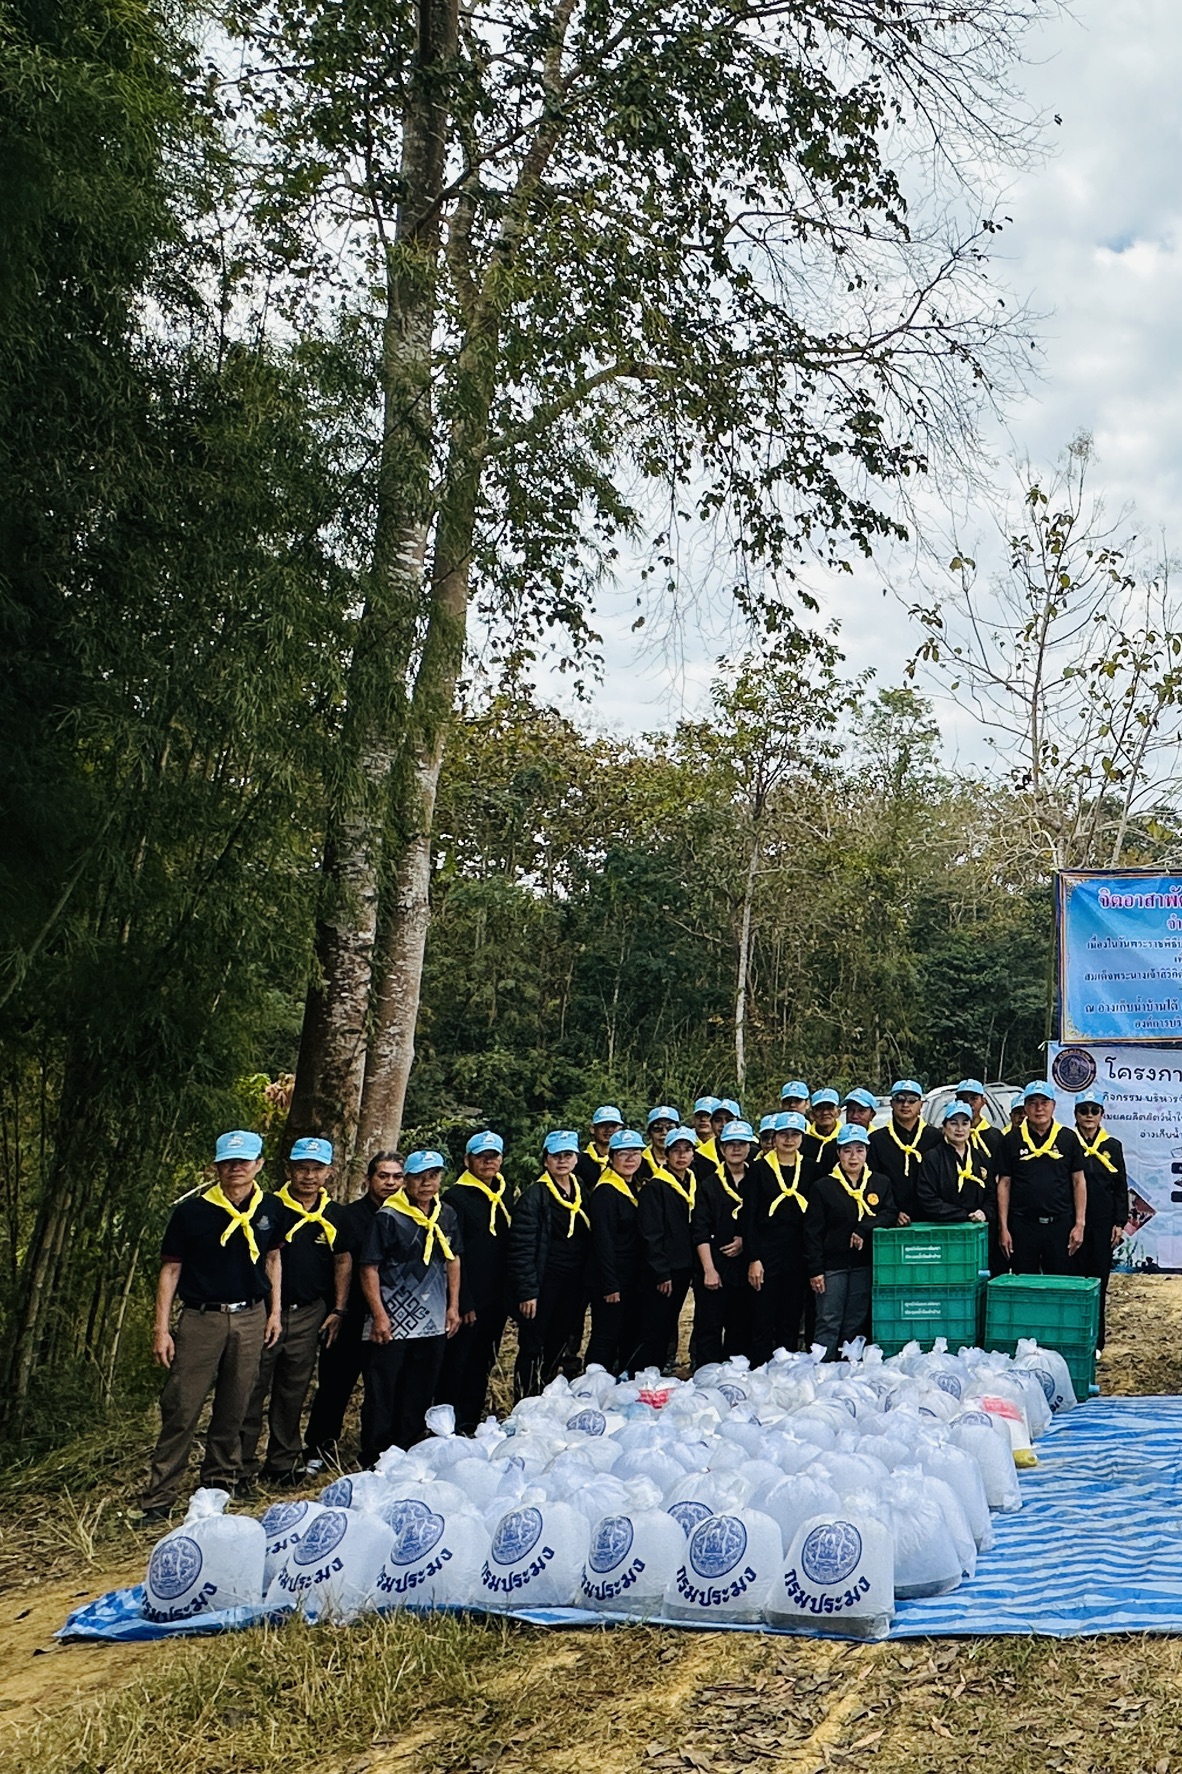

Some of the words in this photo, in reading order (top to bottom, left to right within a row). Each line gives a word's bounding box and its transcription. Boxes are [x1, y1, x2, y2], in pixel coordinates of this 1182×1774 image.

[581, 1558, 646, 1601] มประมง
[677, 1565, 757, 1607] กรมประมง
[784, 1568, 871, 1614] กรมประมง
